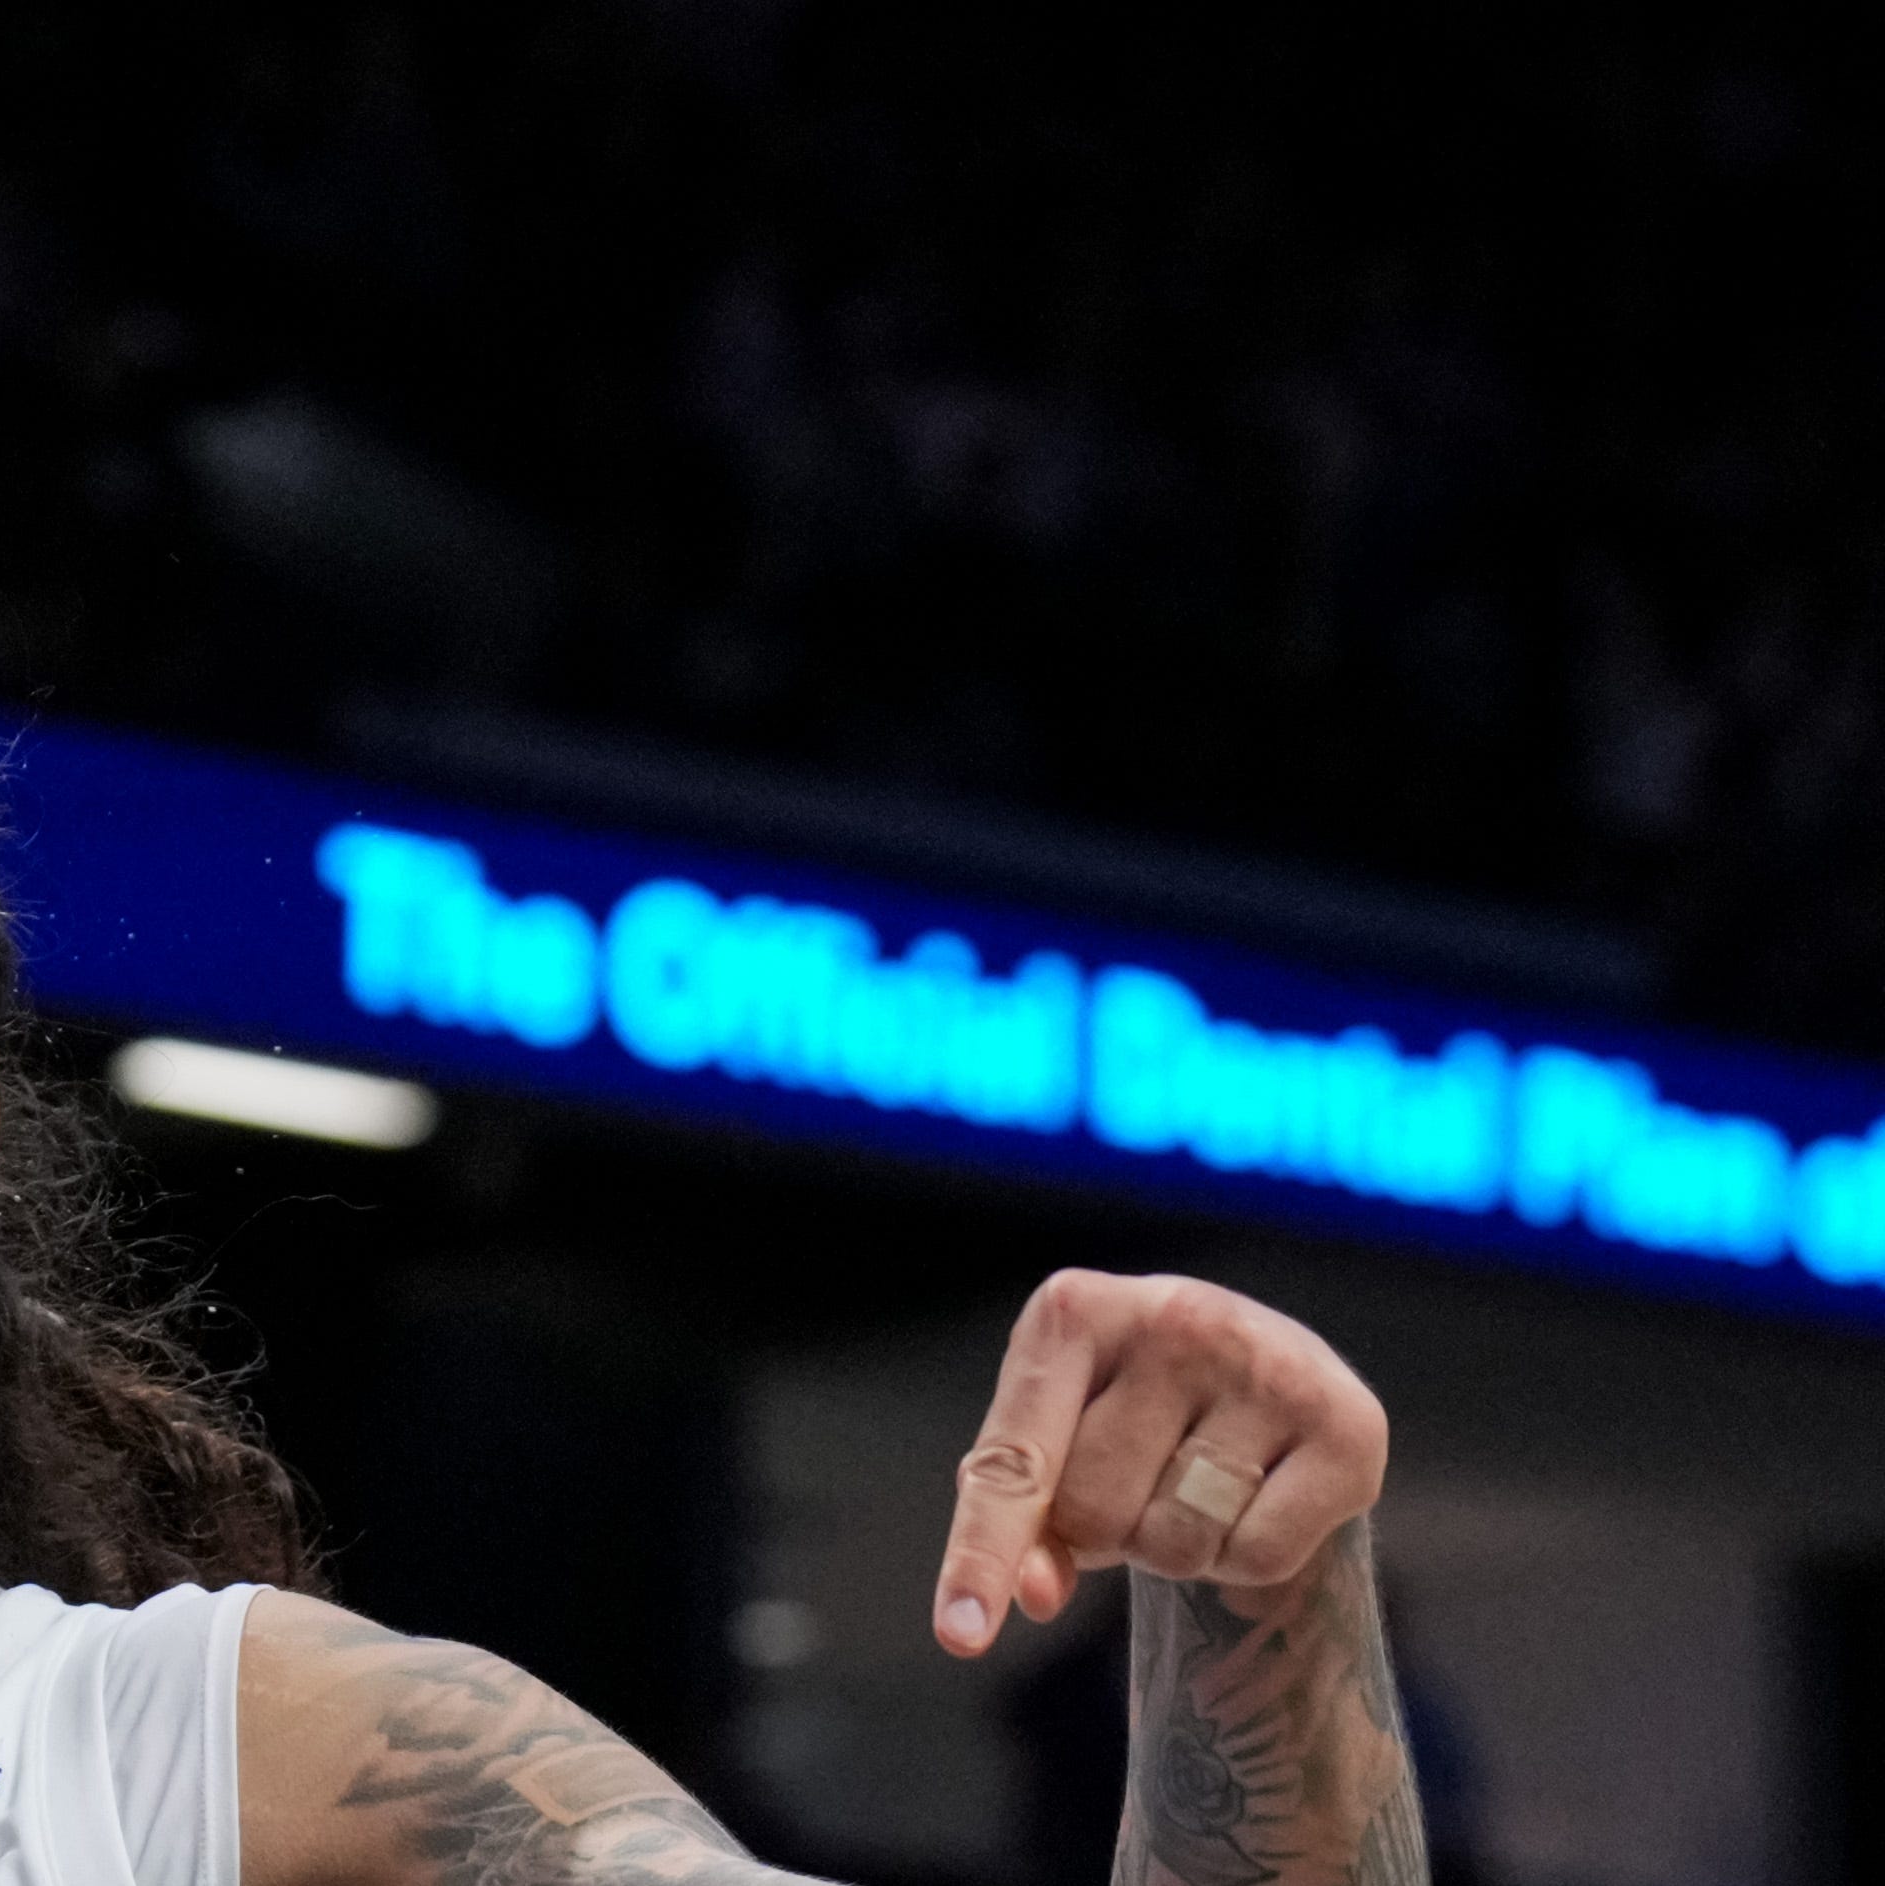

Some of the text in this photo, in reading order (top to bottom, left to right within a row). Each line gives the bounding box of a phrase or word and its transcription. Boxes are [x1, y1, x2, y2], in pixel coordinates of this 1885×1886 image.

[314, 821, 598, 1050] The
[602, 878, 1085, 1133] Official
[1087, 964, 1507, 1215] Dental
[1508, 1044, 1791, 1269] Plan
